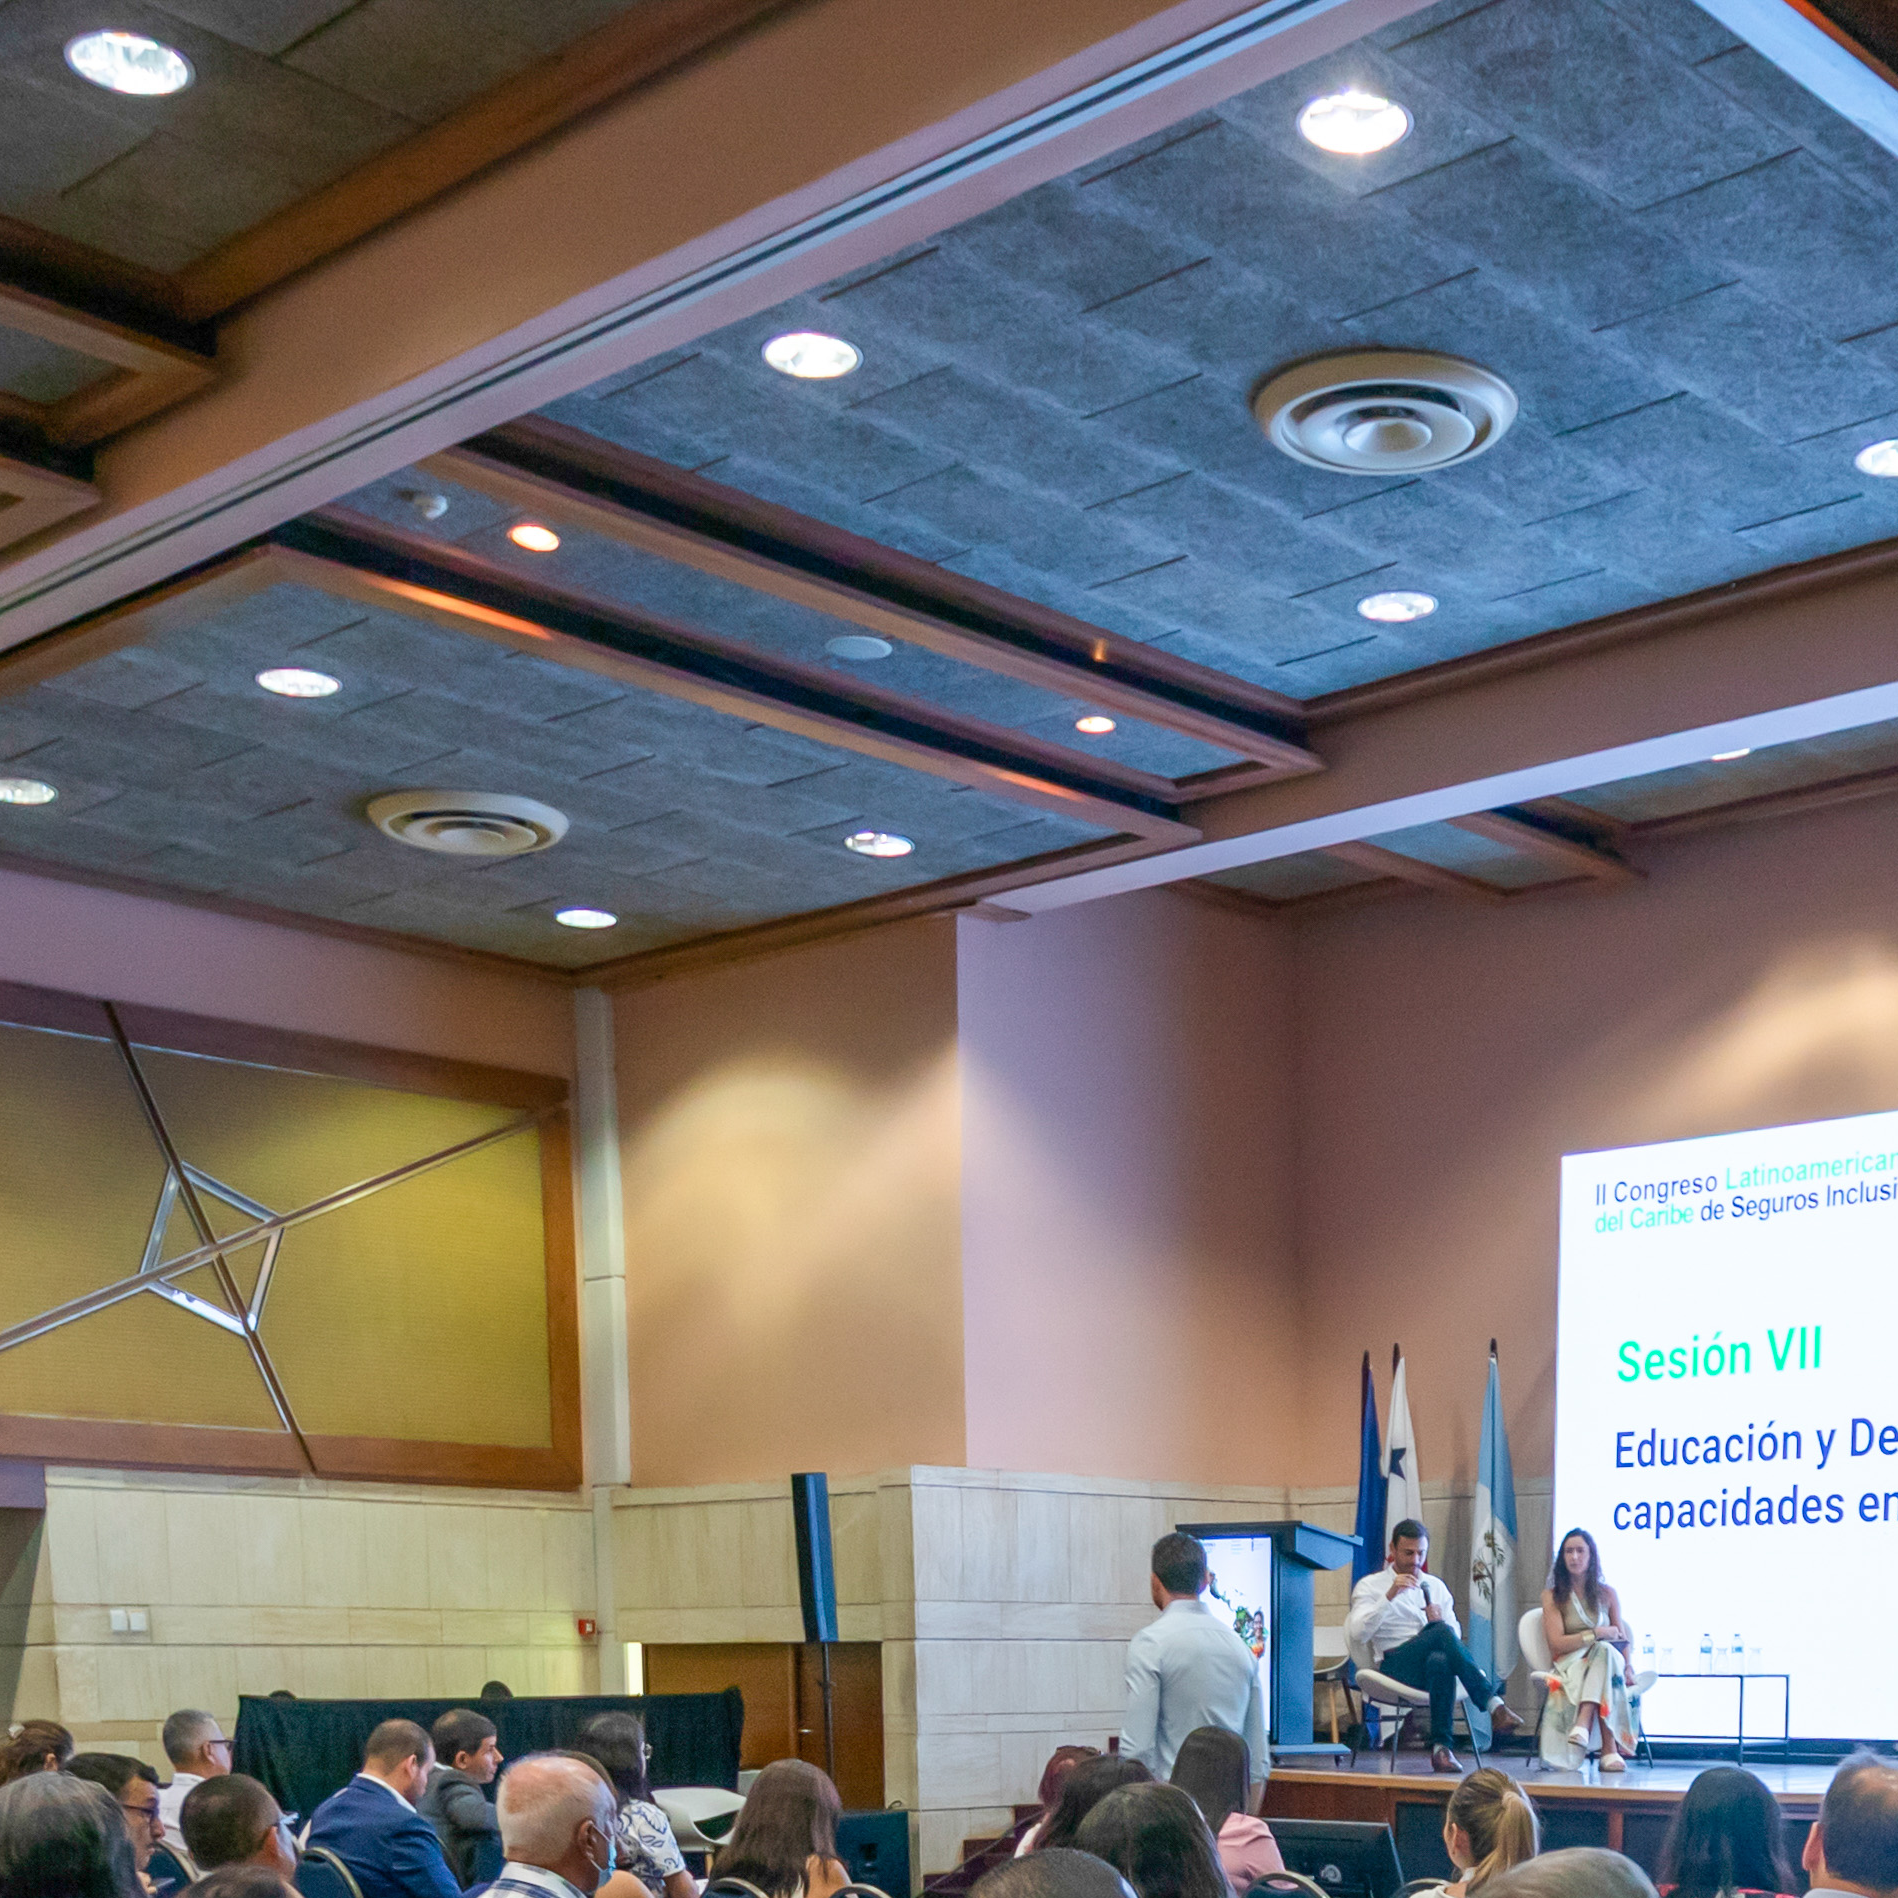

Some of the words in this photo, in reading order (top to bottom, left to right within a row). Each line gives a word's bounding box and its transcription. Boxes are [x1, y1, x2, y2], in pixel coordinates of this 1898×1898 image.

[1595, 1209, 1623, 1233] del
[1630, 1203, 1694, 1229] Caribe
[1700, 1199, 1725, 1222] de
[1731, 1190, 1819, 1221] Seguros
[1596, 1184, 1606, 1205] II
[1614, 1175, 1718, 1205] Congreso
[1617, 1331, 1752, 1383] Sesión
[1766, 1325, 1822, 1371] VII
[1615, 1420, 1802, 1468] Educación
[1815, 1428, 1837, 1470] y
[1613, 1484, 1845, 1539] capacidades
